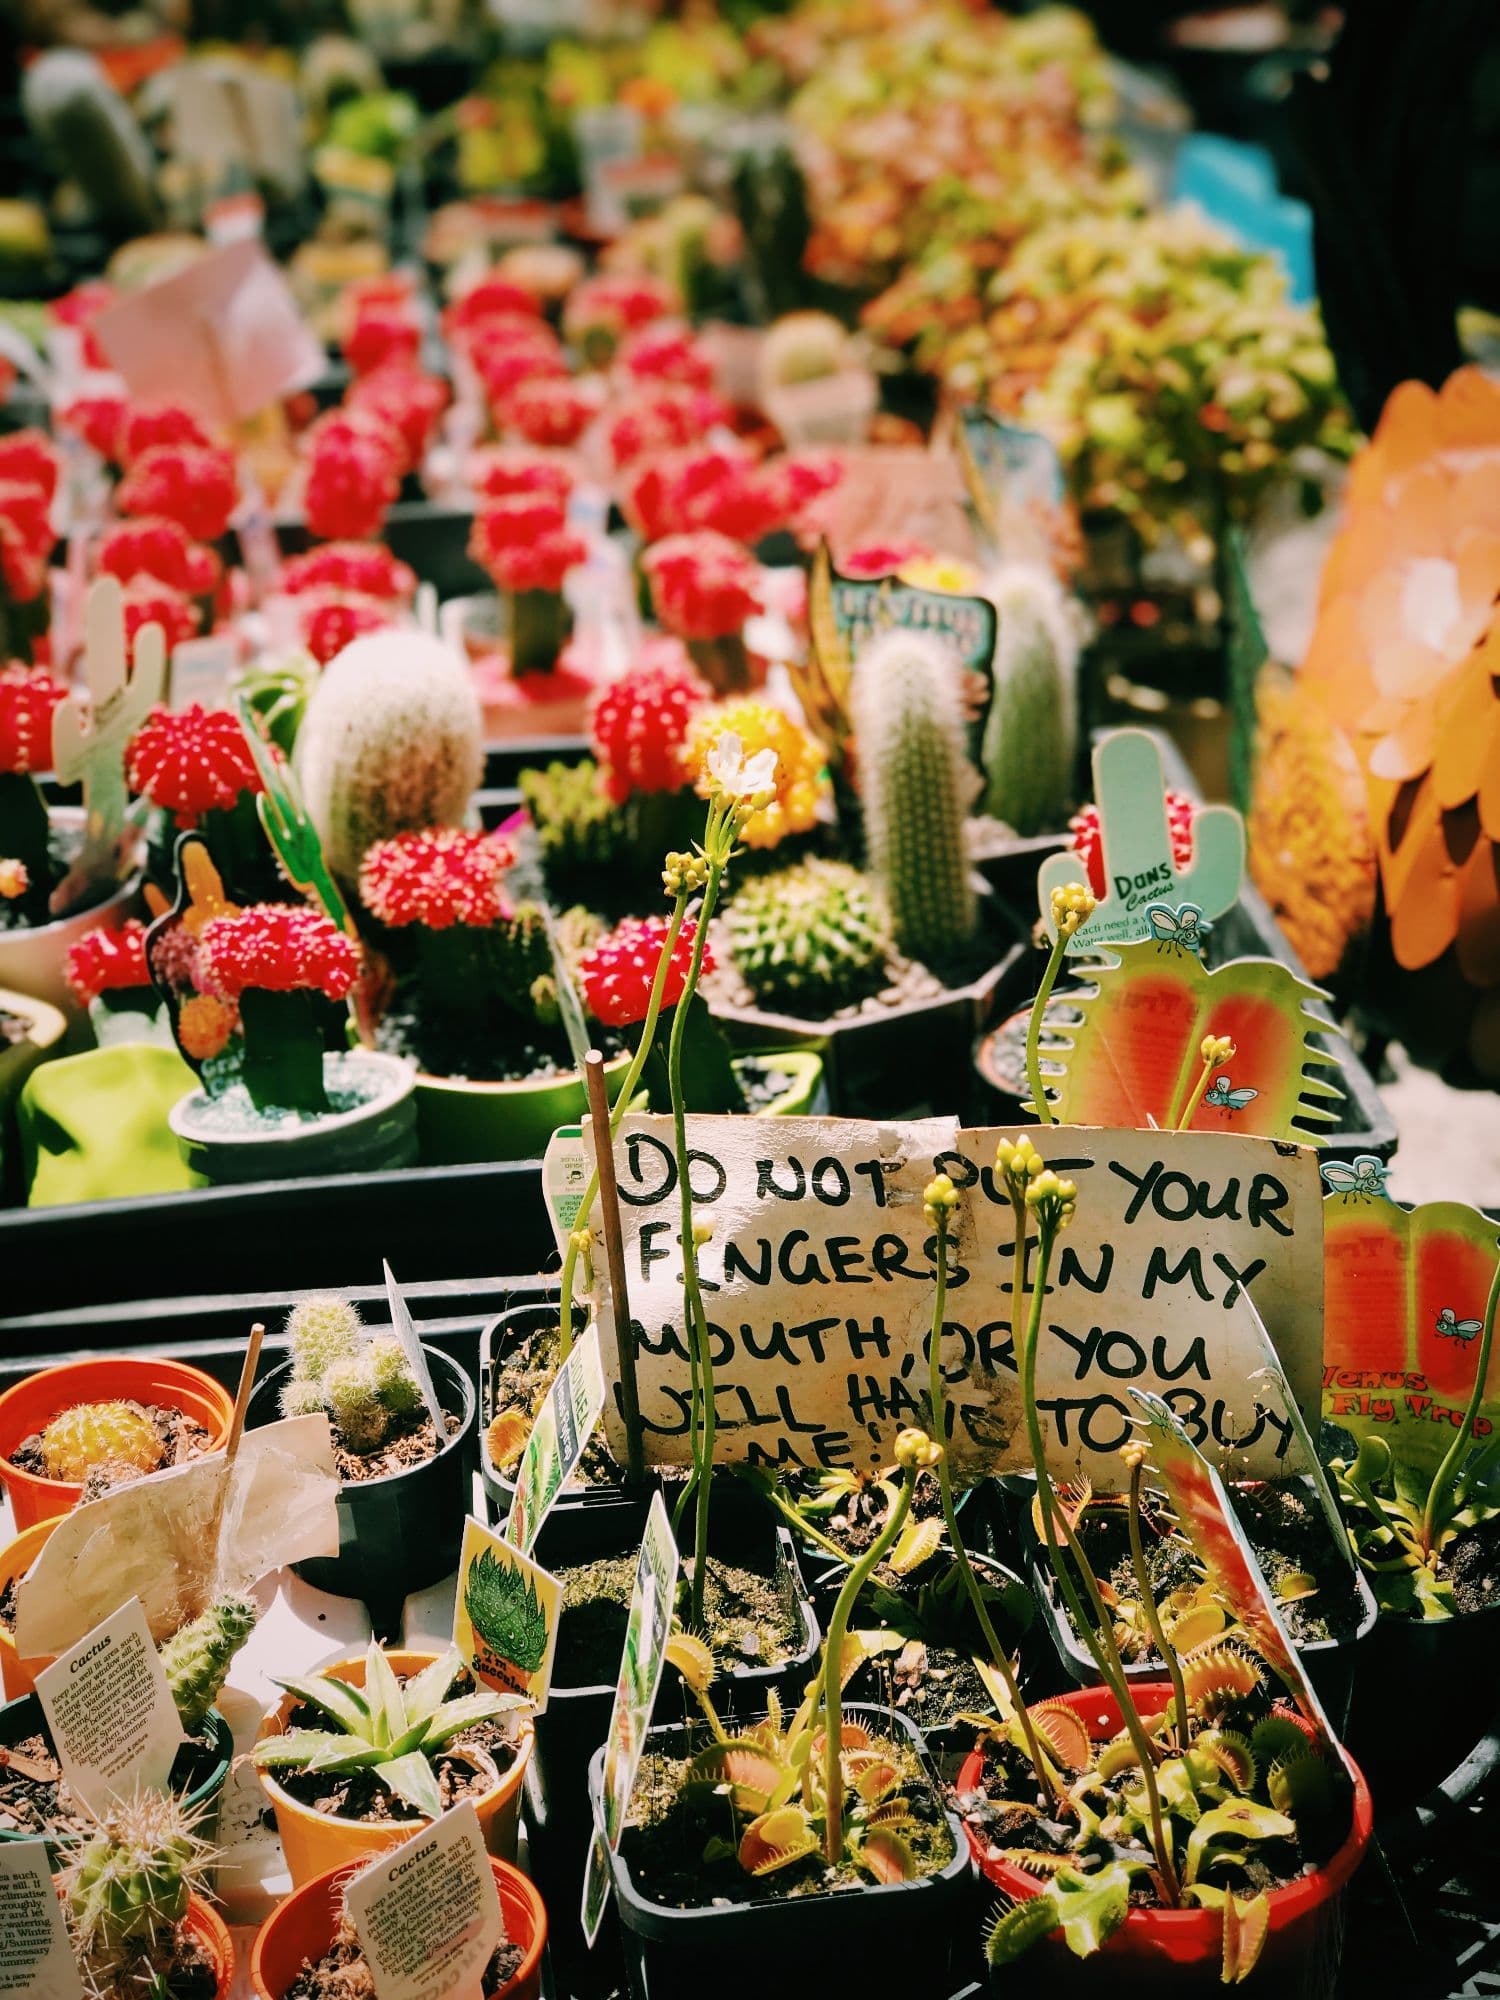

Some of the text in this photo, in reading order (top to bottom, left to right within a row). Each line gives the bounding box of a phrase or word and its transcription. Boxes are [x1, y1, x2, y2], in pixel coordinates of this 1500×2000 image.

[1104, 916, 1130, 931] need
[616, 1132, 727, 1206] DO
[756, 1156, 902, 1208] NOT
[1108, 1160, 1294, 1236] YOUR
[998, 1235, 1114, 1294] IN
[1142, 1246, 1267, 1309] MY
[923, 1322, 1019, 1384] OR
[1048, 1324, 1211, 1380] YOU
[614, 1381, 826, 1436] WILL
[1036, 1394, 1134, 1452] TO
[1162, 1388, 1304, 1458] BUY
[1330, 1393, 1395, 1422] Fly
[70, 1634, 112, 1674] Cactus
[71, 1682, 78, 1690] in
[79, 1667, 93, 1681] well
[104, 1648, 119, 1662] area
[121, 1632, 137, 1648] such
[71, 1680, 91, 1701] sunny
[94, 1657, 119, 1680] window
[123, 1672, 136, 1688] and
[137, 1664, 147, 1676] let
[55, 1700, 80, 1726] putting
[82, 1679, 106, 1702] outside
[84, 1690, 104, 1708] Water
[64, 1734, 74, 1748] dry
[77, 1724, 89, 1737] out
[89, 1706, 111, 1726] before
[84, 1726, 99, 1741] little
[101, 1709, 120, 1726] water
[100, 1731, 120, 1748] when
[122, 1702, 154, 1731] necessary
[12, 1870, 38, 1880] such
[388, 1840, 438, 1882] Cactus
[398, 1874, 415, 1890] well
[428, 1853, 446, 1868] area
[9, 1910, 28, 1918] and
